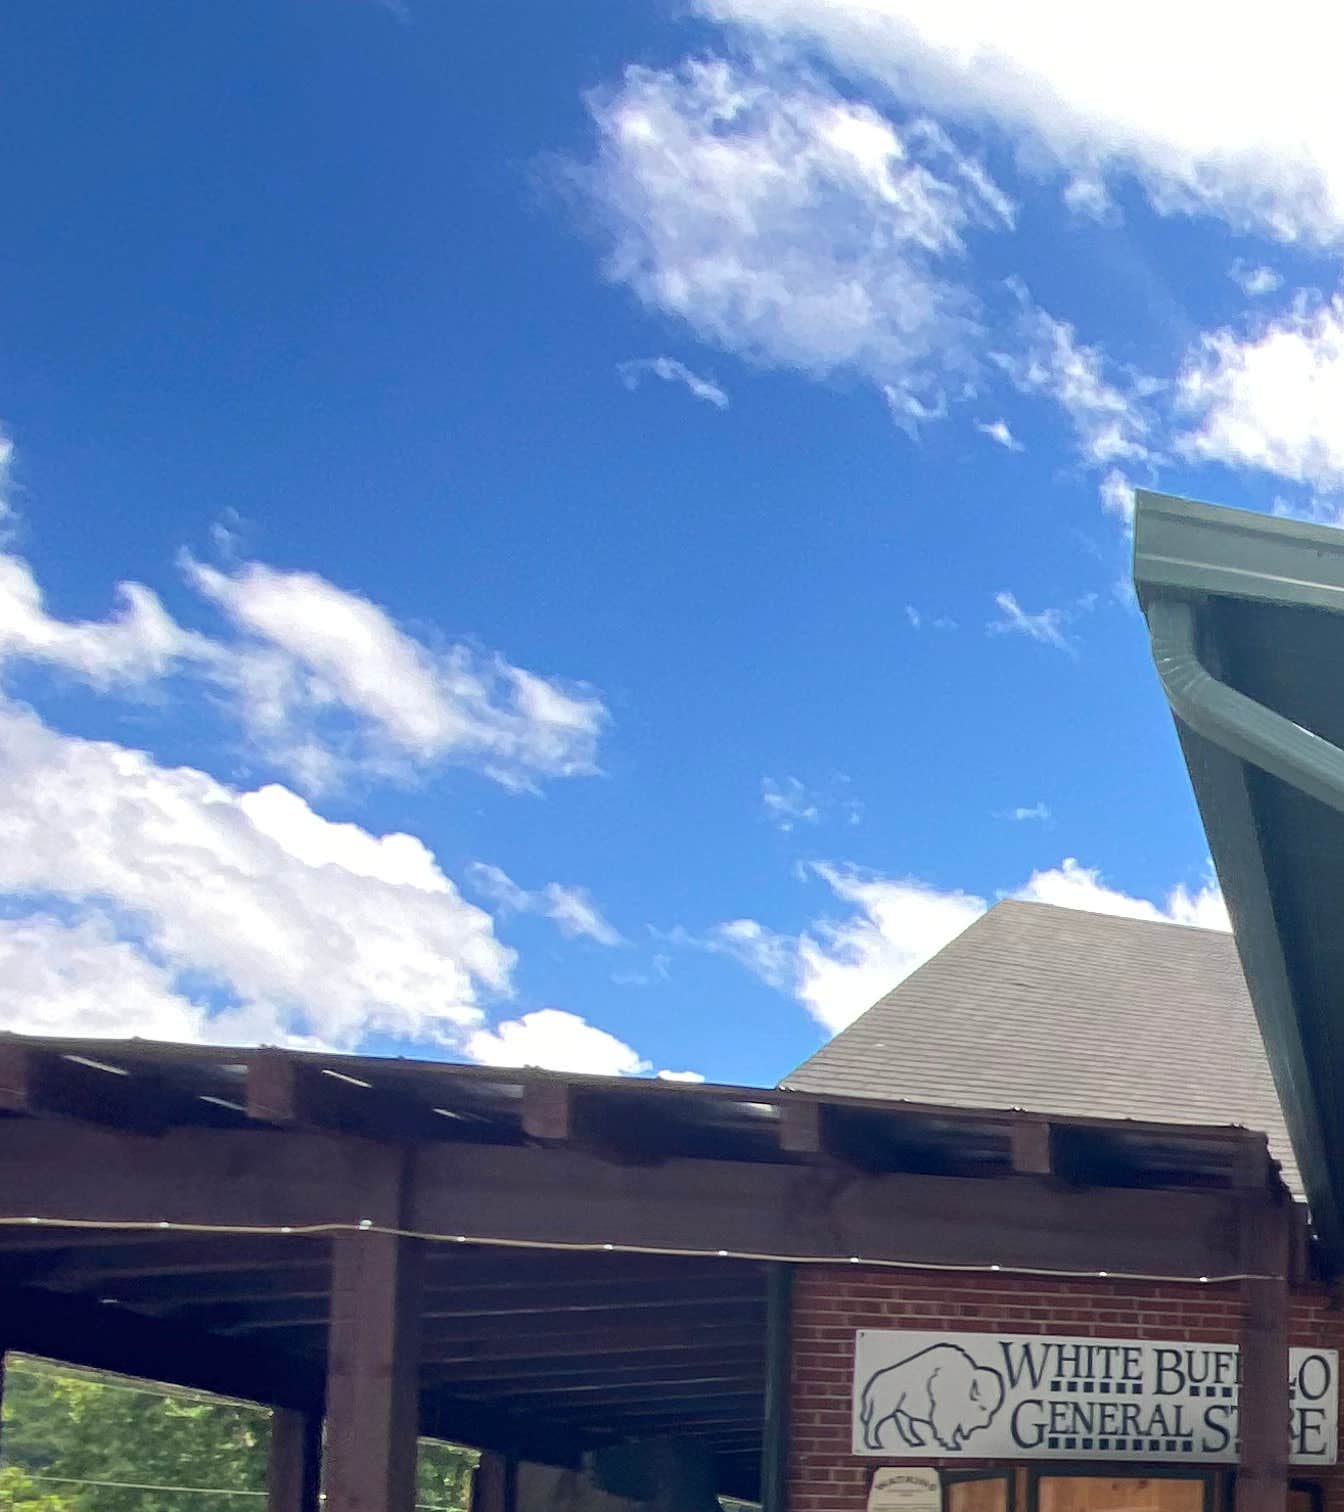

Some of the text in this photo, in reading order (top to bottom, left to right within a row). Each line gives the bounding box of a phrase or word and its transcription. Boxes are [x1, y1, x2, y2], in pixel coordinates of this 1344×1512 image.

[998, 1341, 1331, 1401] WHITE BUFO
[1010, 1398, 1195, 1449] GENERAL
